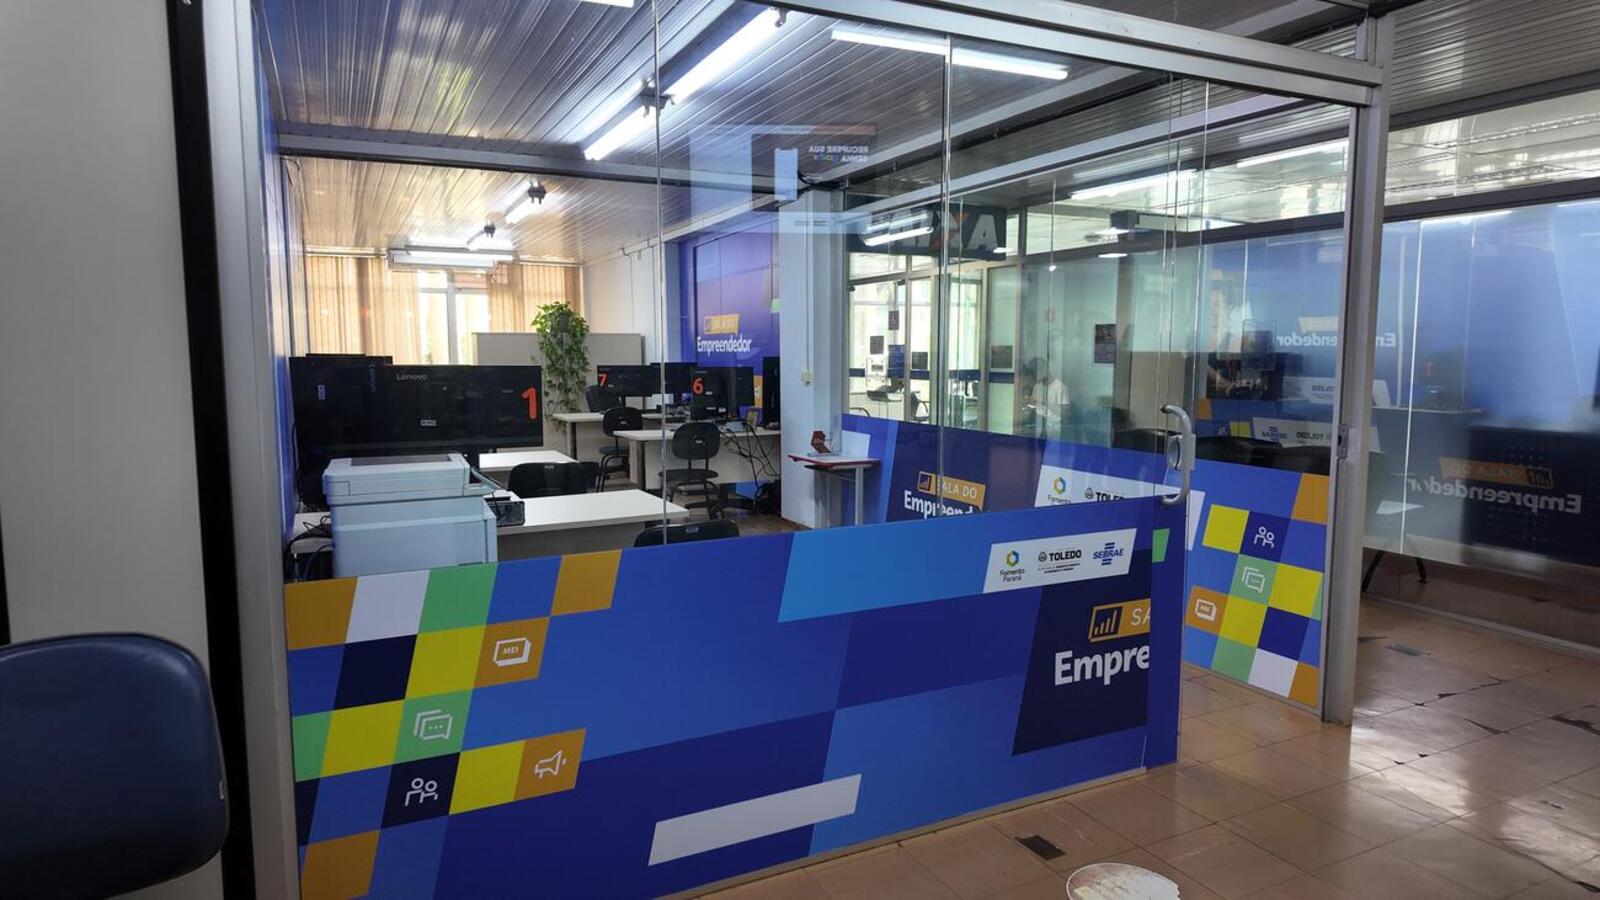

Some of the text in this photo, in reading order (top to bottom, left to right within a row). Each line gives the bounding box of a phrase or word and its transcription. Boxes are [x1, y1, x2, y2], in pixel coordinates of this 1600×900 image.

[697, 334, 752, 357] Empreendedor
[396, 373, 428, 381] Lenovo
[598, 373, 607, 386] 7
[692, 377, 704, 394] 6
[521, 387, 538, 420] 1
[963, 486, 977, 499] DO
[1048, 549, 1082, 562] TOLEDO
[1093, 548, 1124, 559] SEBRAE
[1000, 567, 1025, 577] Fomento
[1055, 644, 1150, 686] Empre
